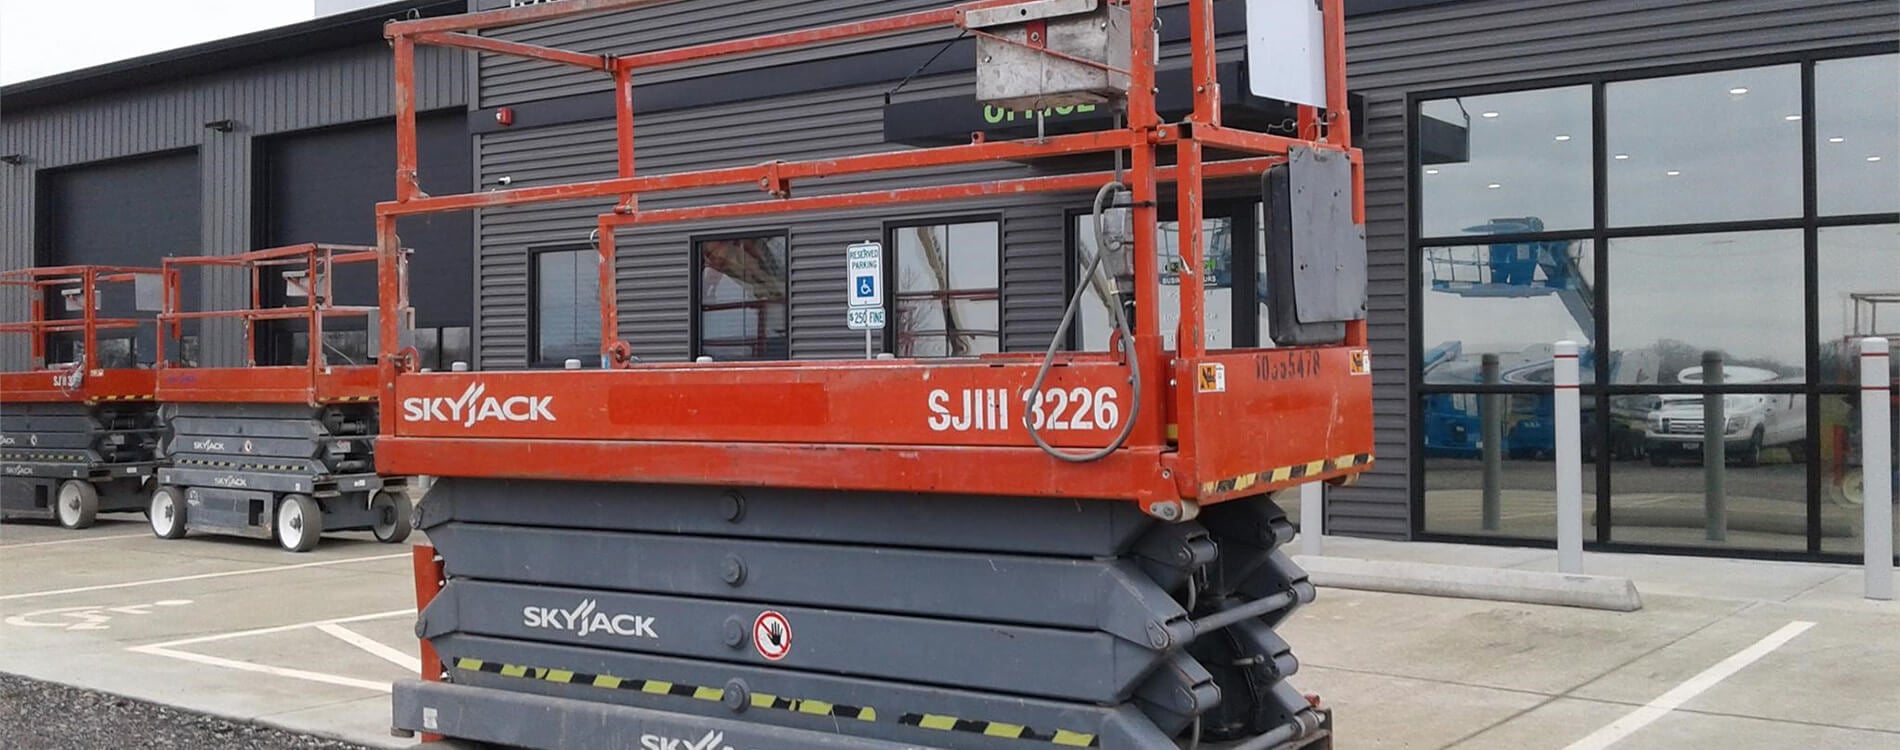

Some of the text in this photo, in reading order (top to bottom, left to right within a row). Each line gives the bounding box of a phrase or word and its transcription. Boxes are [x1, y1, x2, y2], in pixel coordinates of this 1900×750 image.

[849, 249, 878, 259] RESERVED
[851, 260, 877, 270] PARKING
[849, 311, 884, 323] $250 FINE
[403, 381, 557, 428] SKYJACK
[1022, 386, 1119, 431] 3226
[523, 598, 659, 638] SKYJACK
